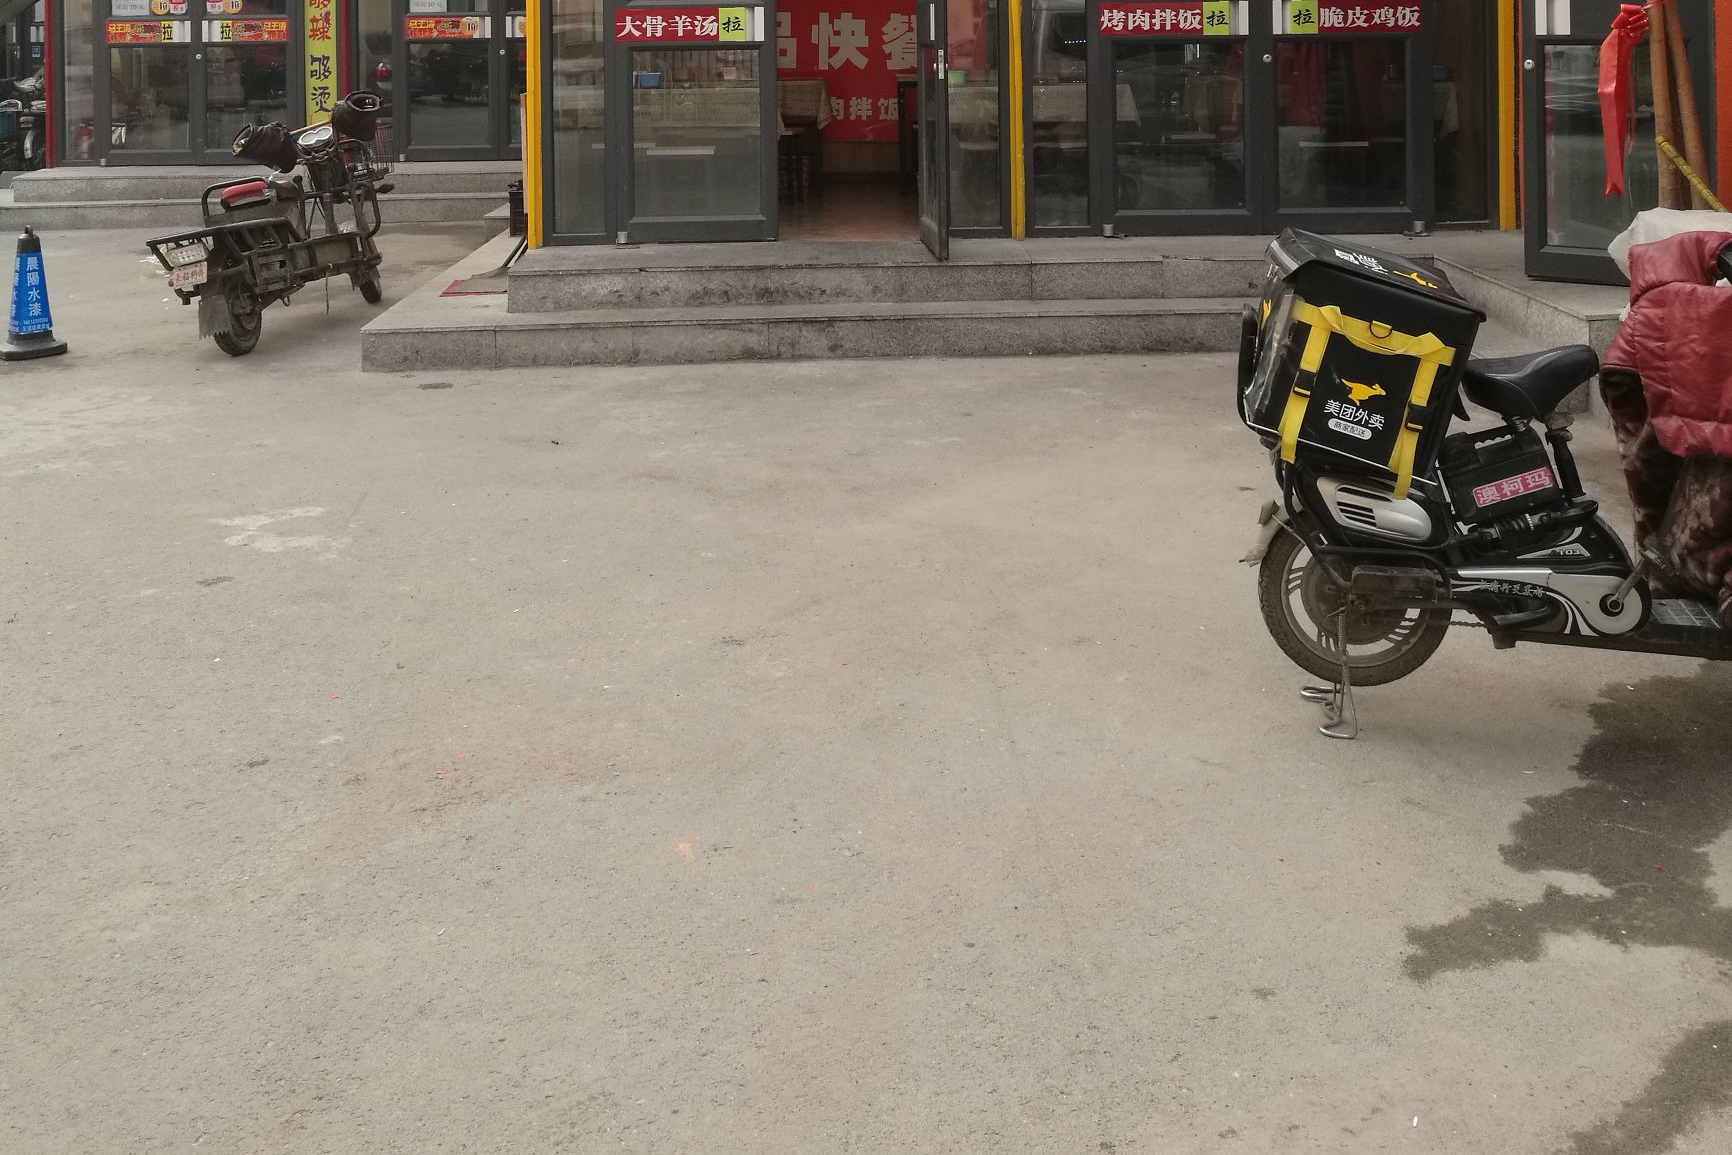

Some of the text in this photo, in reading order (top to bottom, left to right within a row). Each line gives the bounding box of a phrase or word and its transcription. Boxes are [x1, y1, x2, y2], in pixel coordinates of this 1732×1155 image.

[616, 15, 719, 39] 大骨羊汤
[722, 16, 744, 33] 拉
[1100, 8, 1202, 31] 烤肉拌饭
[1206, 9, 1227, 27] 拉
[1293, 9, 1315, 27] 拉
[1319, 6, 1421, 29] 脆皮鸡饭
[162, 23, 173, 40] 拉
[220, 23, 232, 40] 拉
[1323, 399, 1385, 431] 美团外卖
[1476, 470, 1550, 504] 澳柯玛
